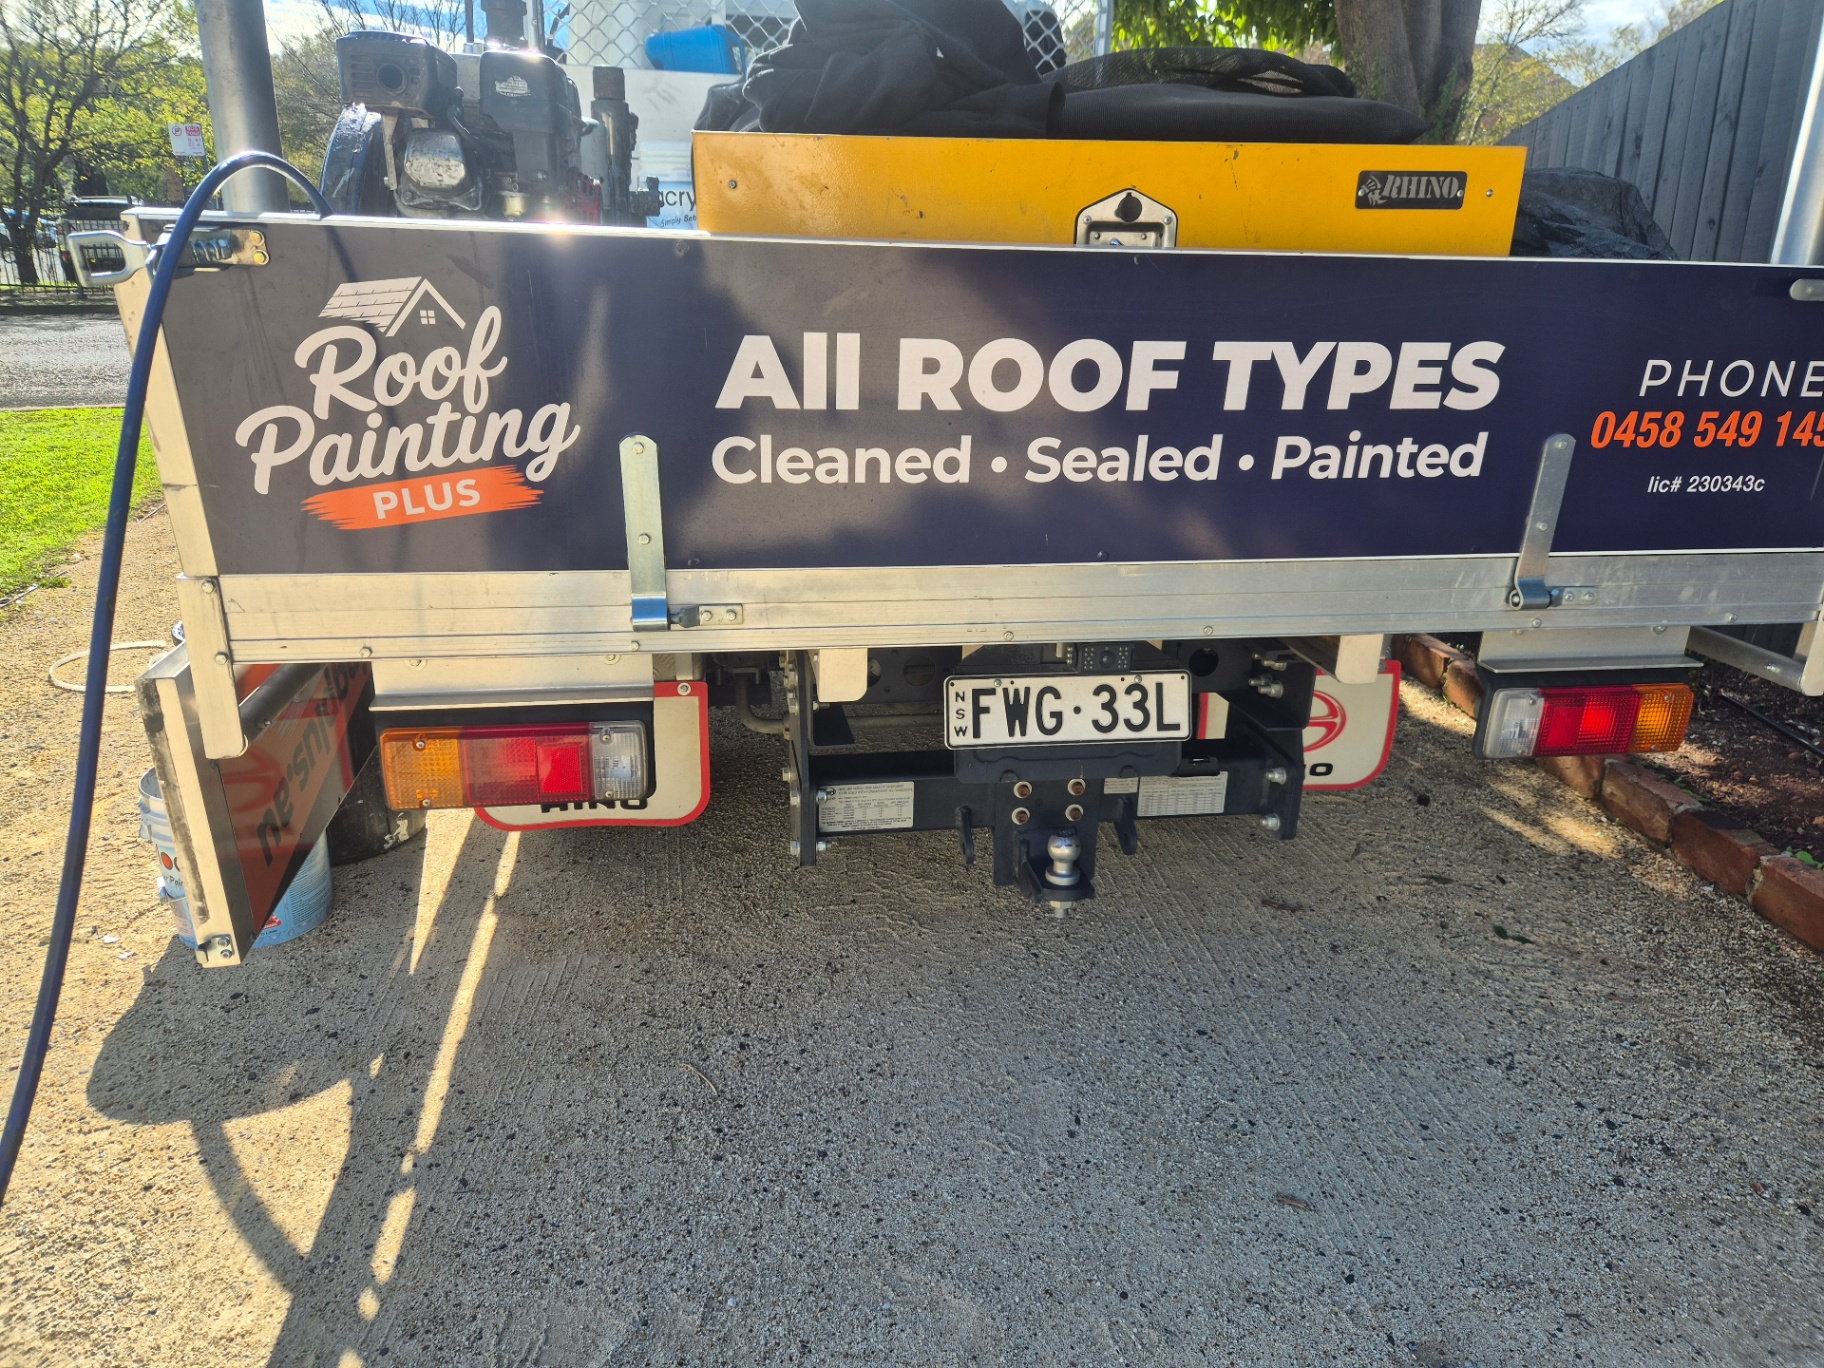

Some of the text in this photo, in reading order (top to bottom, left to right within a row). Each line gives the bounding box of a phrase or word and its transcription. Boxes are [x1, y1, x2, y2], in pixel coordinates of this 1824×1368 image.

[1382, 174, 1459, 199] RHINO
[294, 305, 508, 420] Roof
[716, 332, 1506, 412] All ROOF TYPES
[1639, 359, 1824, 397] PHONE
[235, 401, 581, 495] Painting
[1590, 411, 1685, 449] 0458
[1693, 411, 1763, 448] 549
[711, 431, 1489, 485] Cleaned Sealed Painted
[372, 478, 481, 519] PLUS
[1647, 475, 1765, 493] lic# 230343c
[954, 691, 968, 737] NSW
